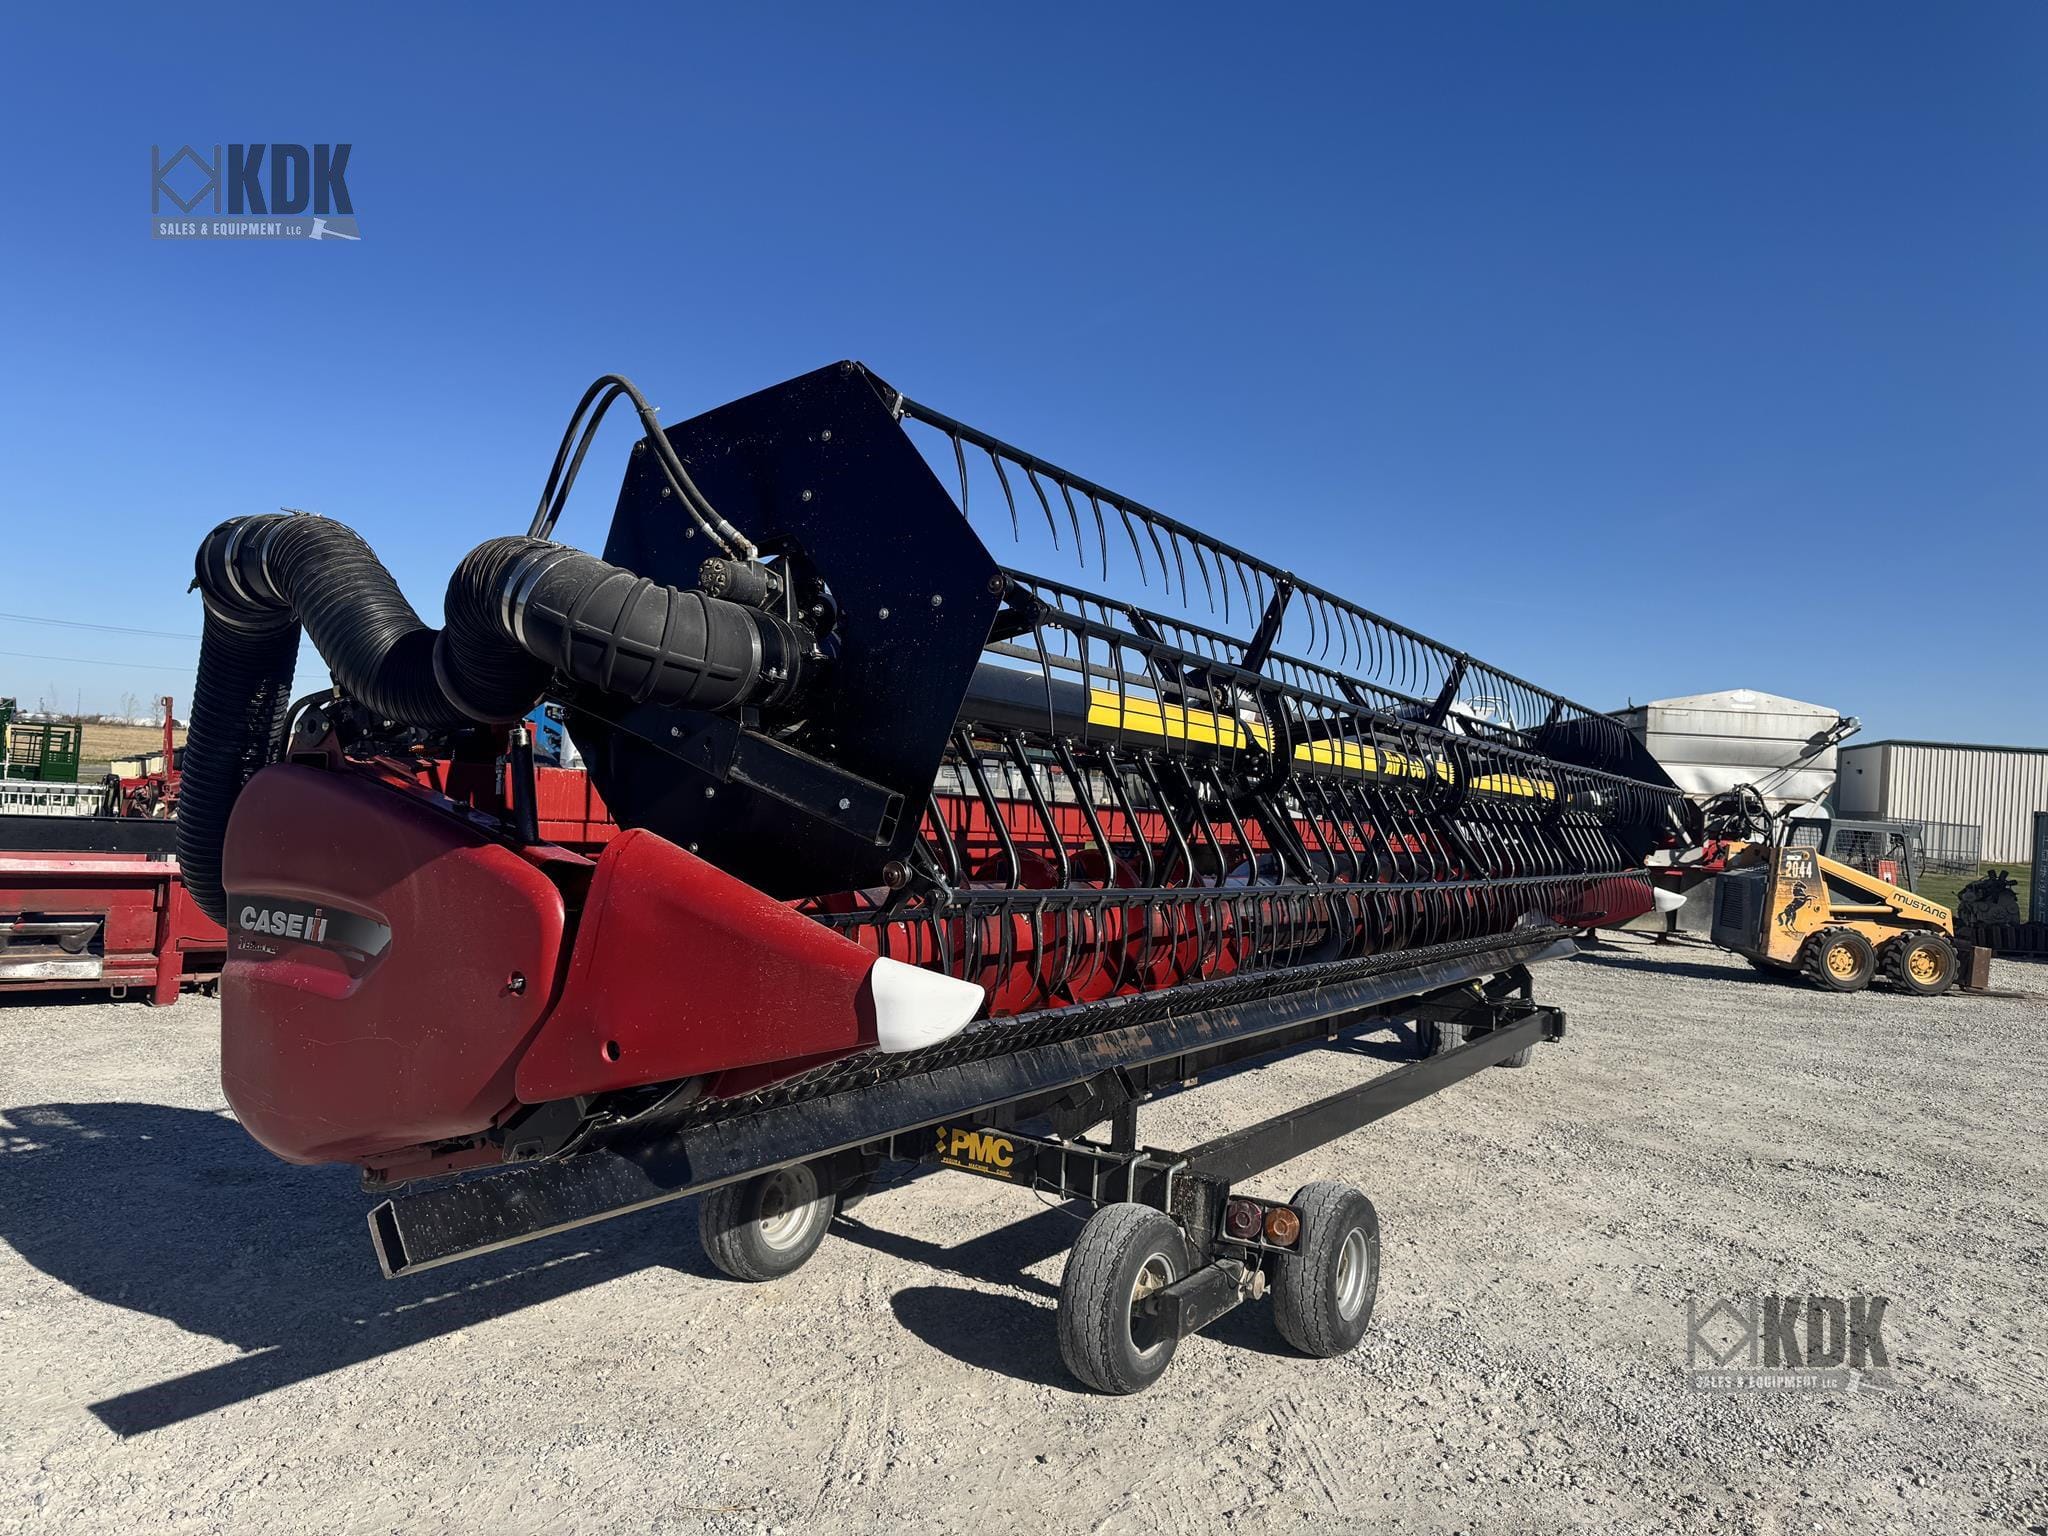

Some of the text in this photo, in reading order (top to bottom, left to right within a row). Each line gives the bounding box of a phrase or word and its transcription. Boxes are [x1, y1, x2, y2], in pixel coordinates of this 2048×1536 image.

[1785, 860, 1813, 879] 2044
[1892, 892, 1949, 920] MUSTANG
[239, 905, 304, 938] CASE
[950, 1127, 1014, 1168] PMC
